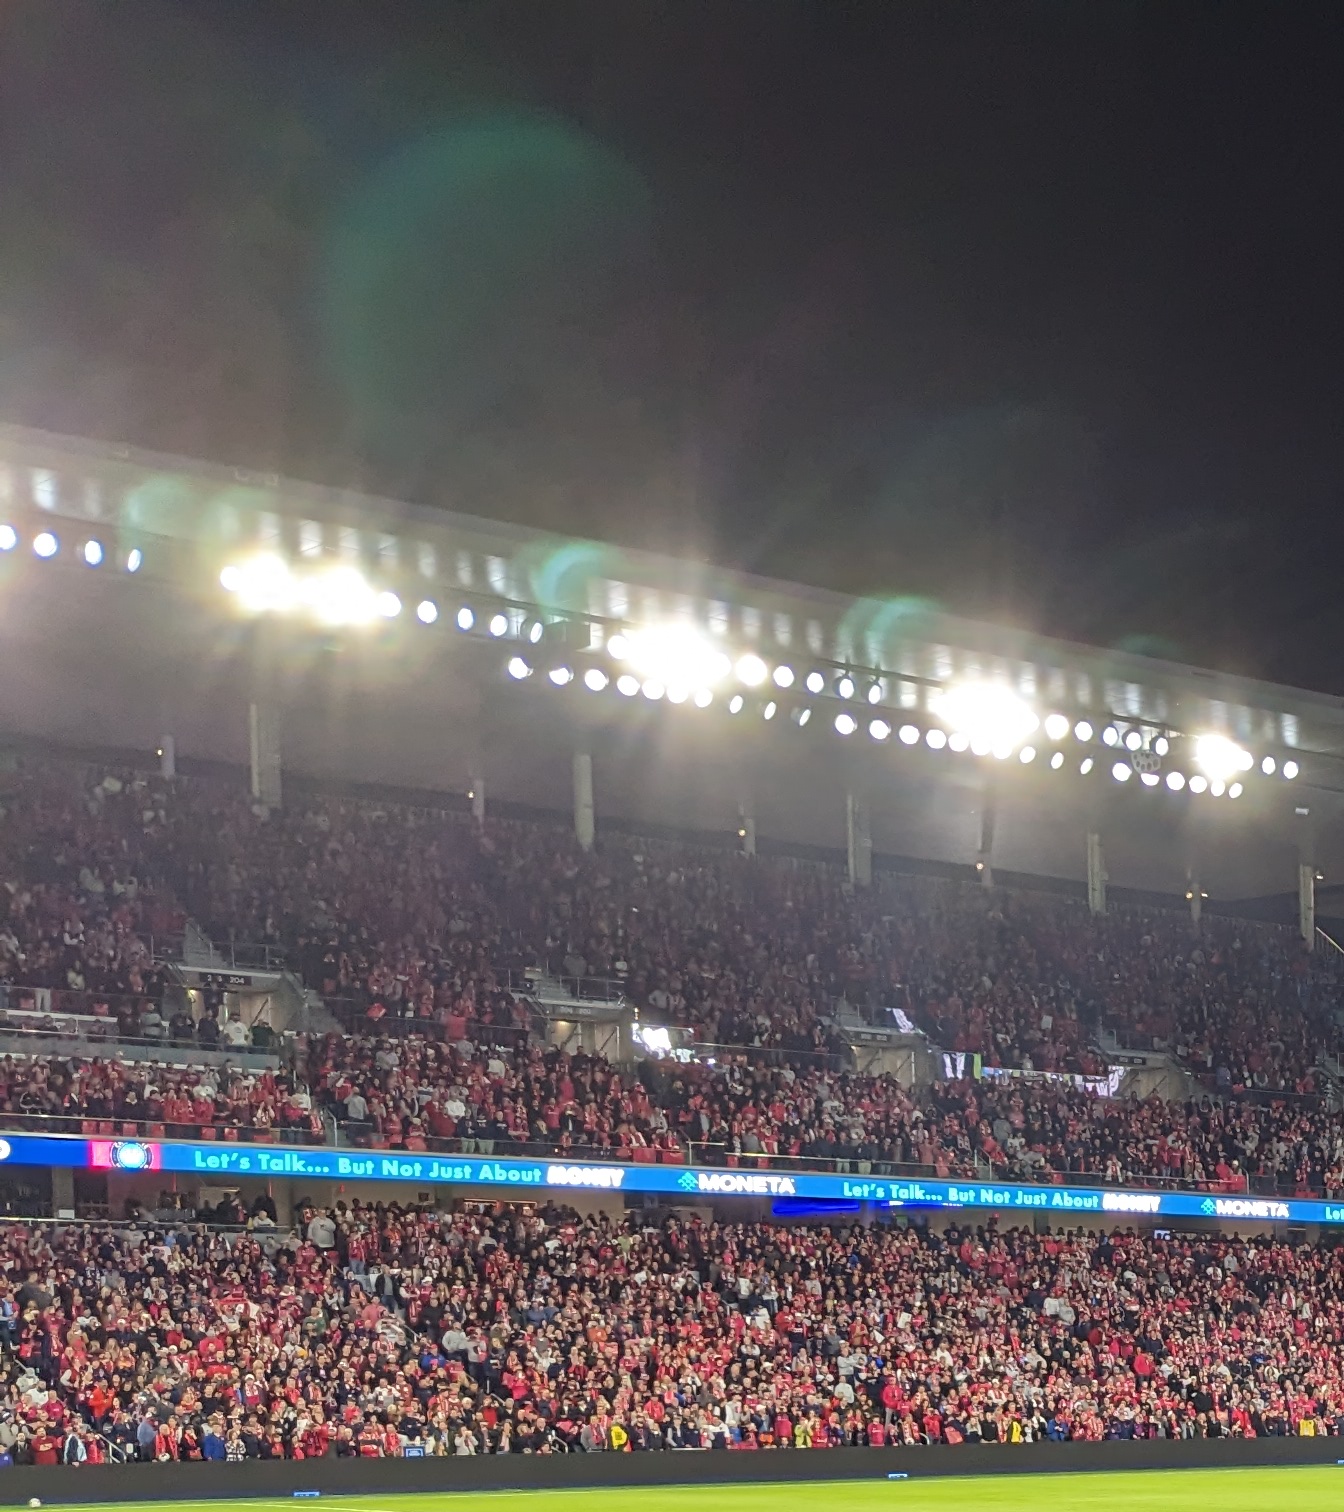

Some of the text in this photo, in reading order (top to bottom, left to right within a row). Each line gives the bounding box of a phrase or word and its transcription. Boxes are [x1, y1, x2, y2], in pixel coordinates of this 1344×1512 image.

[194, 1150, 251, 1170] Let's
[257, 1153, 330, 1173] Talk...
[338, 1157, 374, 1175] But
[382, 1159, 422, 1177] Not
[429, 1162, 471, 1179] Just
[478, 1164, 541, 1182] About
[697, 1173, 796, 1194] MONETA
[843, 1182, 884, 1198] Let's
[889, 1184, 943, 1201] Talk...
[948, 1187, 976, 1202] But
[980, 1188, 1010, 1204] Not
[1015, 1190, 1047, 1205] Just
[1051, 1192, 1099, 1208] About
[1215, 1199, 1290, 1218] MONETA
